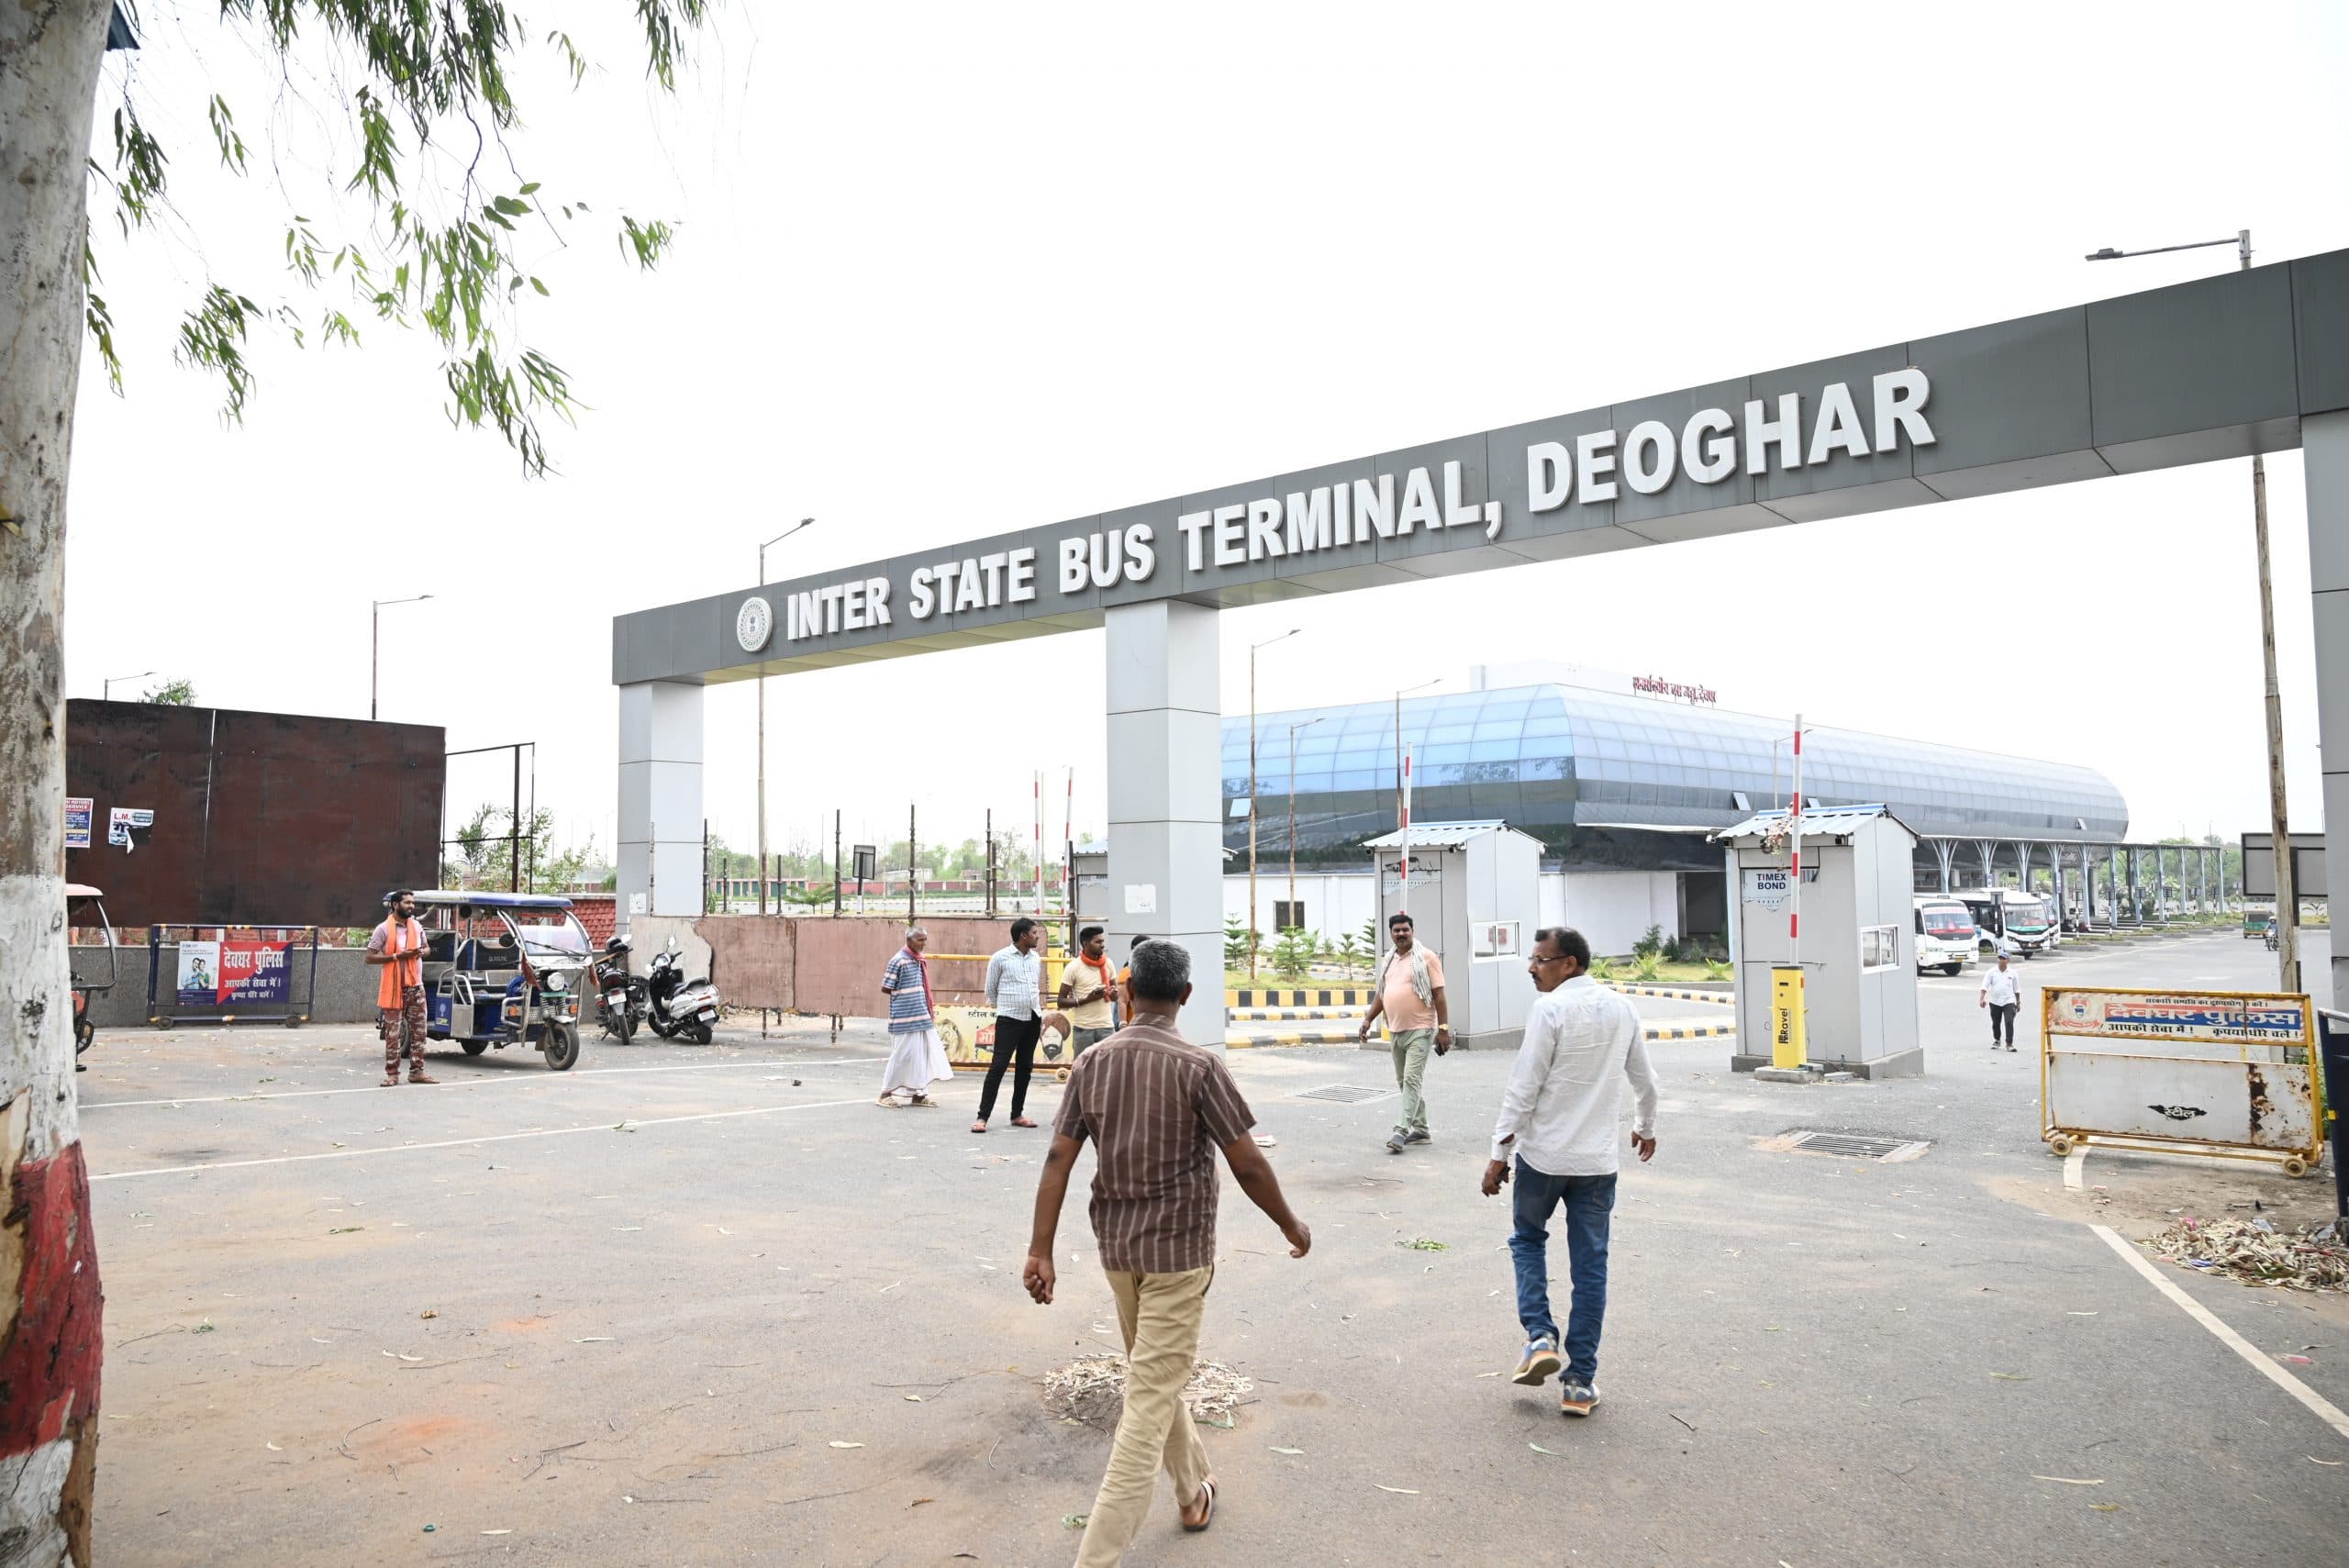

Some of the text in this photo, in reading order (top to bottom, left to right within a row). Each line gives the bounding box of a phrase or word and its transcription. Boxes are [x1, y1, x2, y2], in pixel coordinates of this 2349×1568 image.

[787, 366, 1937, 640] INTER STATE BUS TERMINAL, DEOGHAR
[1756, 873, 1786, 881] TIMEX
[1757, 882, 1786, 890] BOND
[223, 946, 285, 974] देवघर पुलिस
[224, 977, 250, 988] आपकी
[252, 977, 269, 988] सेवा
[968, 1009, 988, 1018] स्टील
[2108, 1004, 2196, 1020] देवघर
[1780, 1007, 1788, 1035] Ravel
[2109, 1023, 2147, 1032] आपकी
[2151, 1024, 2173, 1033] सेवा
[2212, 1028, 2245, 1037] कृपया
